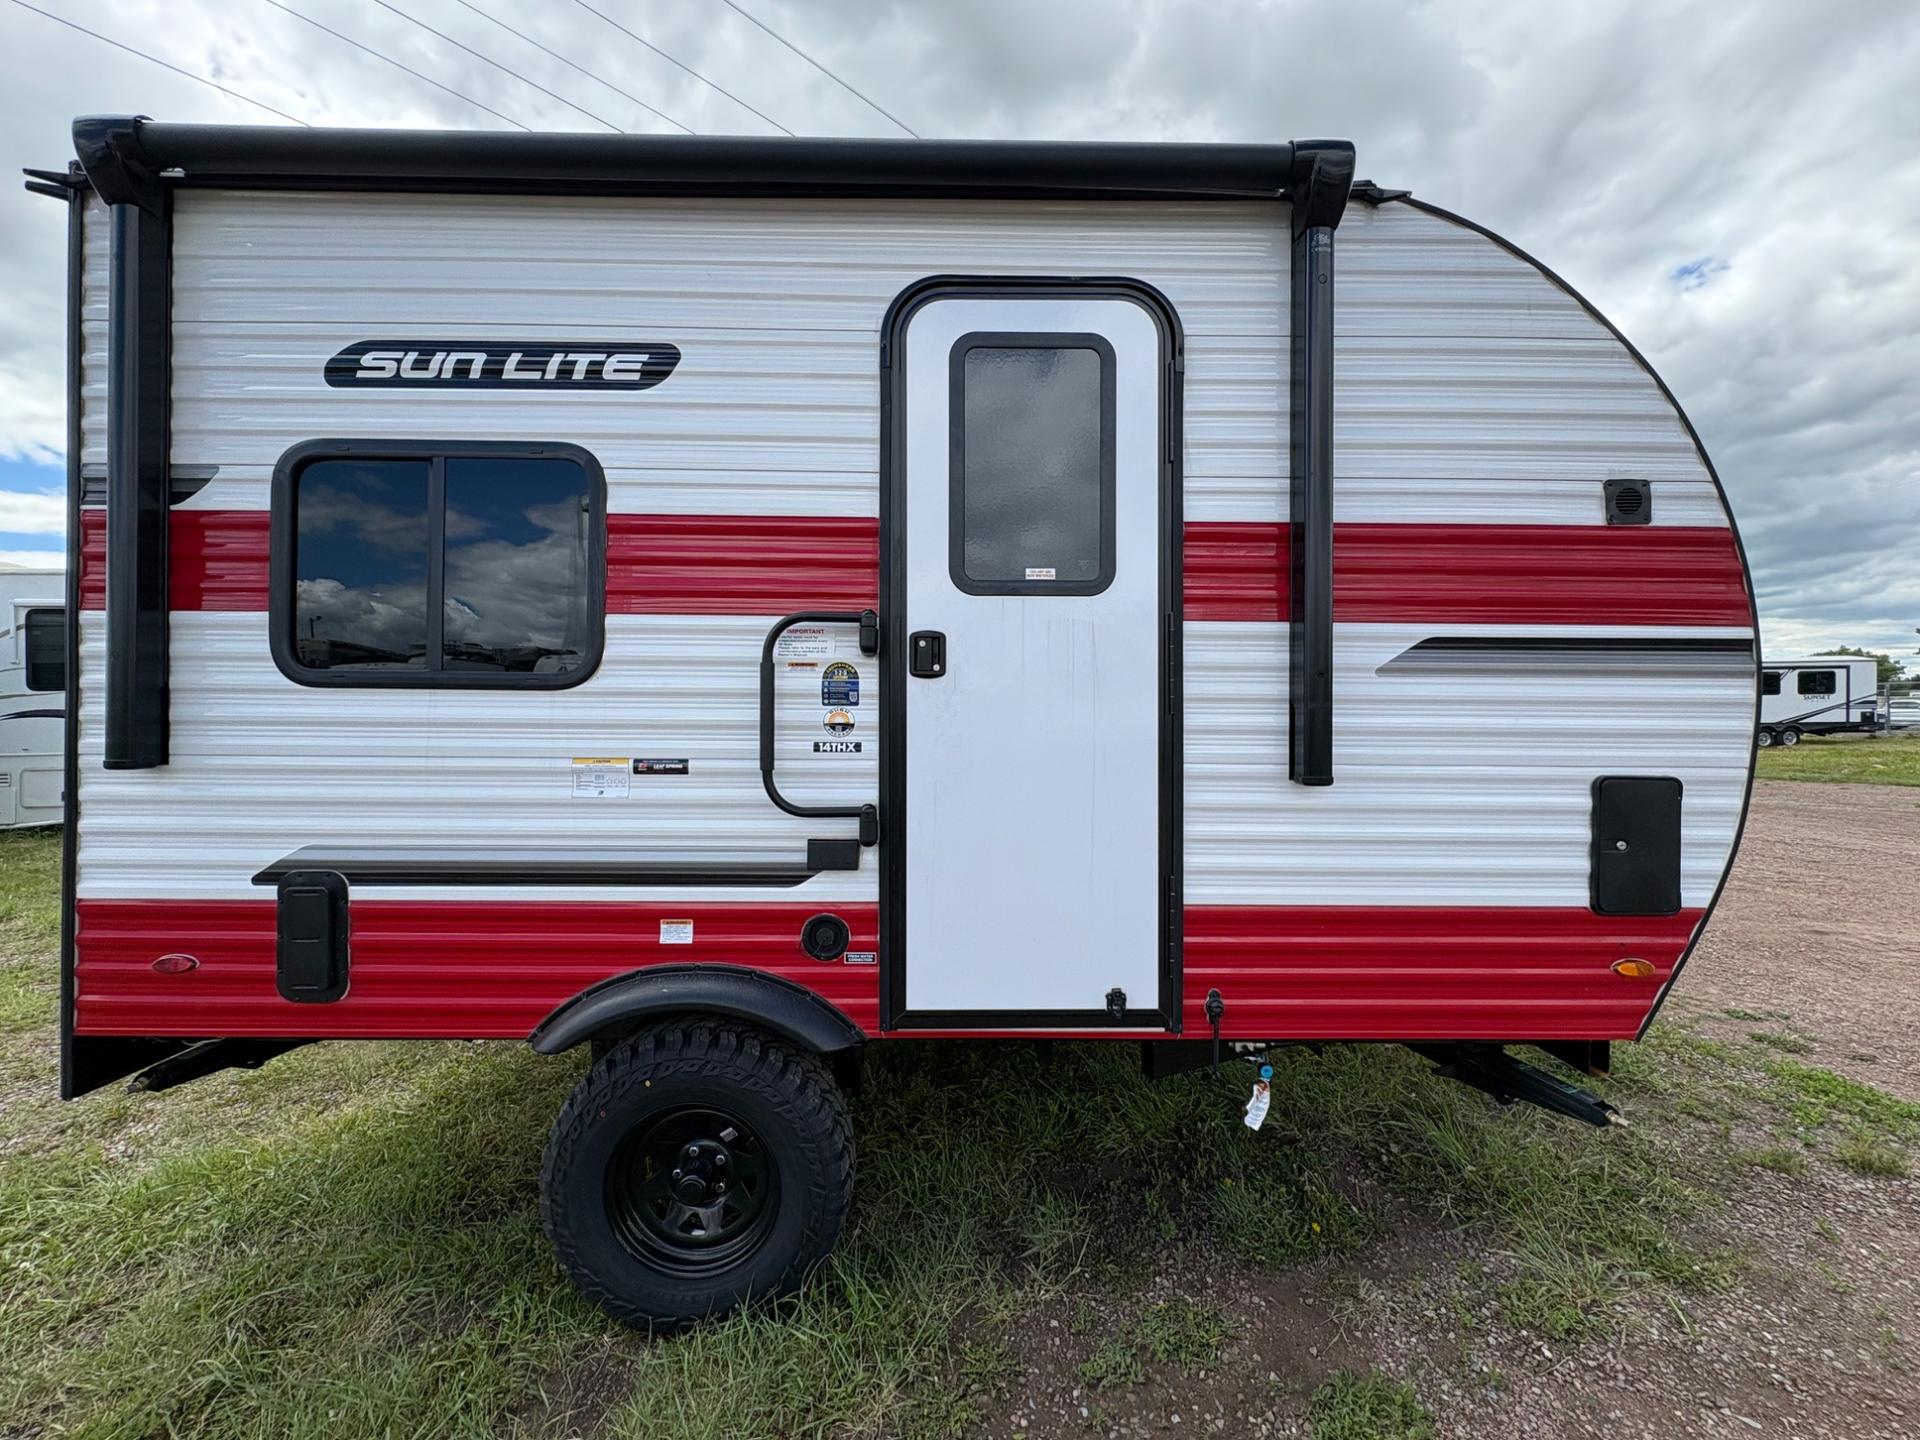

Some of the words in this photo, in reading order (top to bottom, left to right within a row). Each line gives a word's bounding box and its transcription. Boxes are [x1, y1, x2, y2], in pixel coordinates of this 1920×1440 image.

[355, 351, 488, 380] SUN
[501, 352, 650, 381] LITE
[818, 742, 856, 753] 14THX
